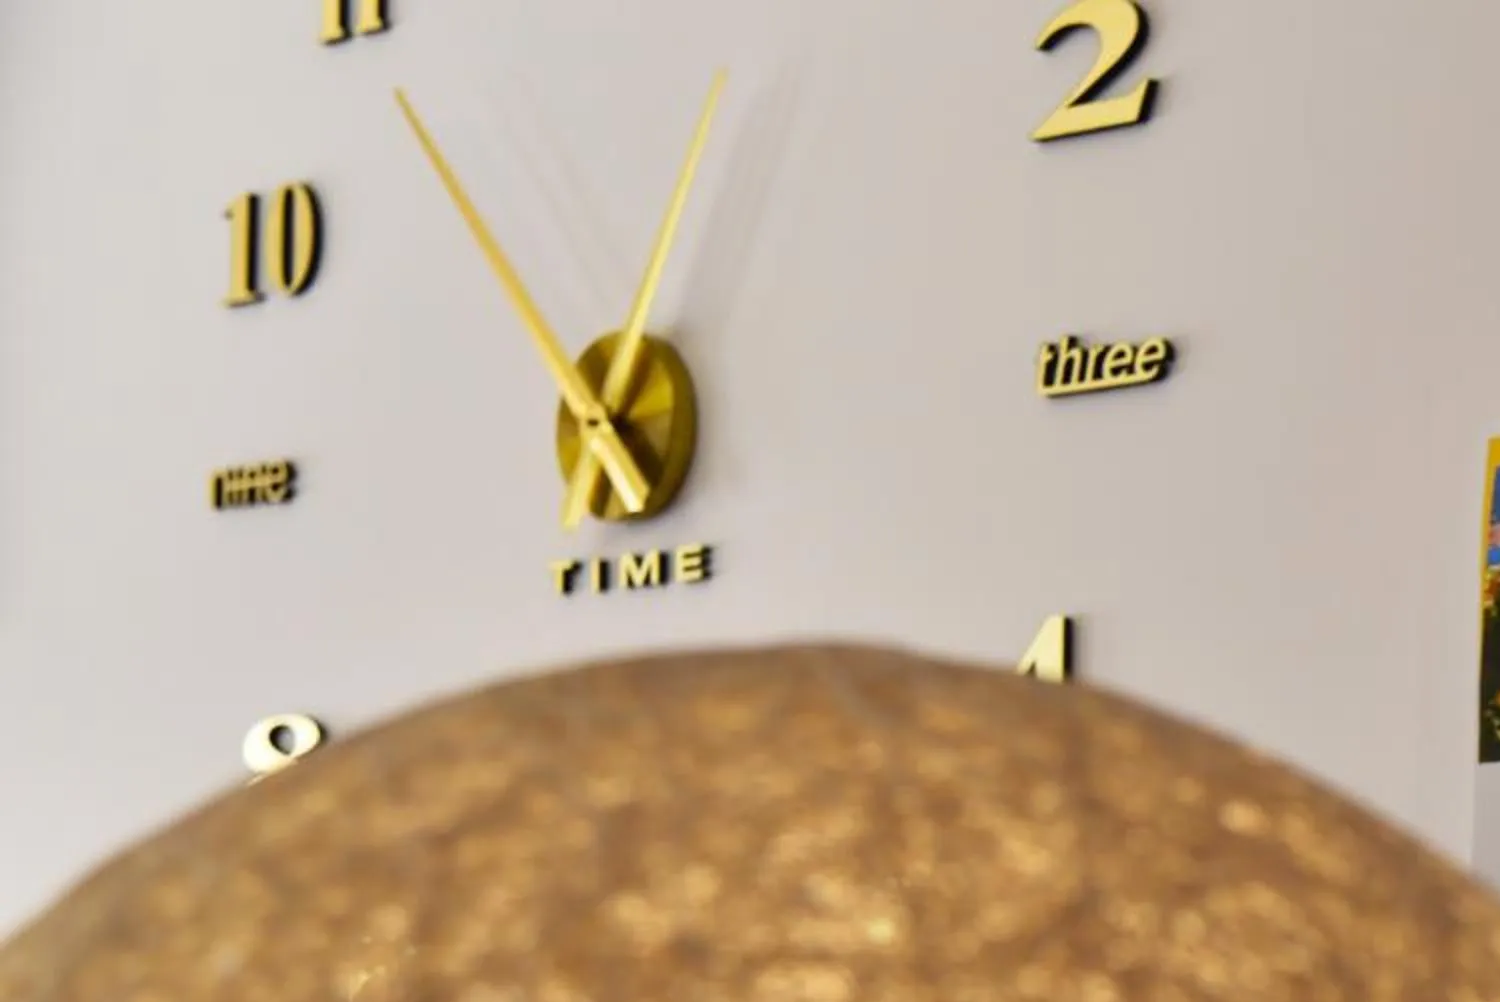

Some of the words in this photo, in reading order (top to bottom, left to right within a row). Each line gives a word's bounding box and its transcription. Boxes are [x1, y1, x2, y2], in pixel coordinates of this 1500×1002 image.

[1030, 0, 1158, 142] 2
[222, 180, 323, 308] 10
[1036, 335, 1176, 399] three
[550, 543, 713, 596] TIME
